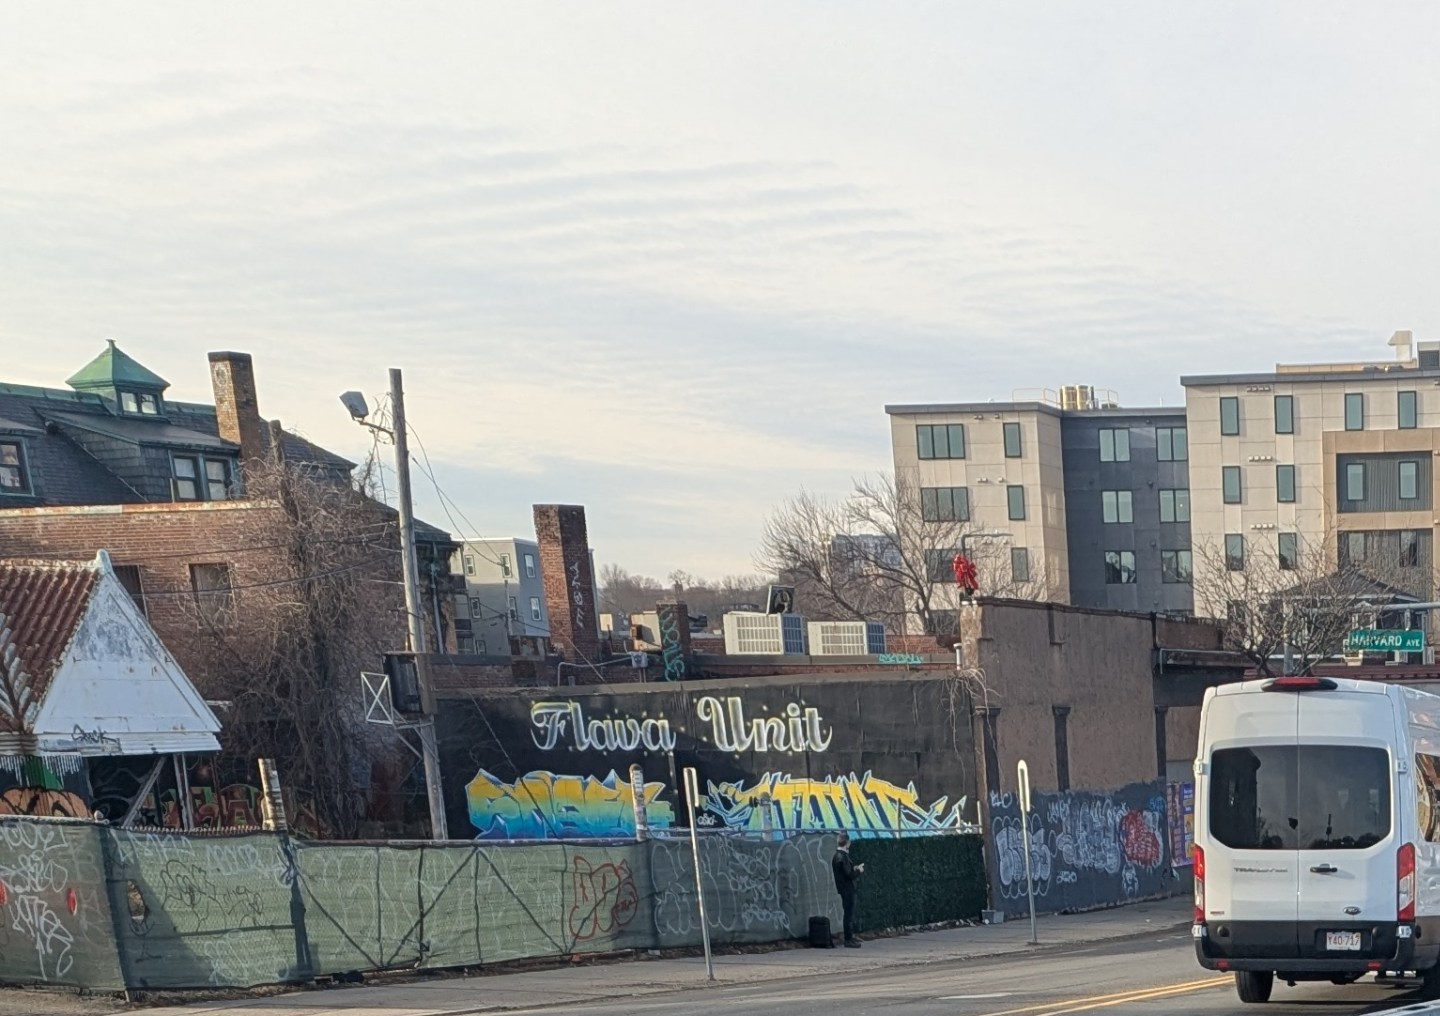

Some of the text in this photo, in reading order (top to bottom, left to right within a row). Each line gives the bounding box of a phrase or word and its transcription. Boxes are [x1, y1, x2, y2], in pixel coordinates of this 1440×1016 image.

[1351, 635, 1420, 646] HARVARD AVE
[530, 696, 834, 752] Flava Unit
